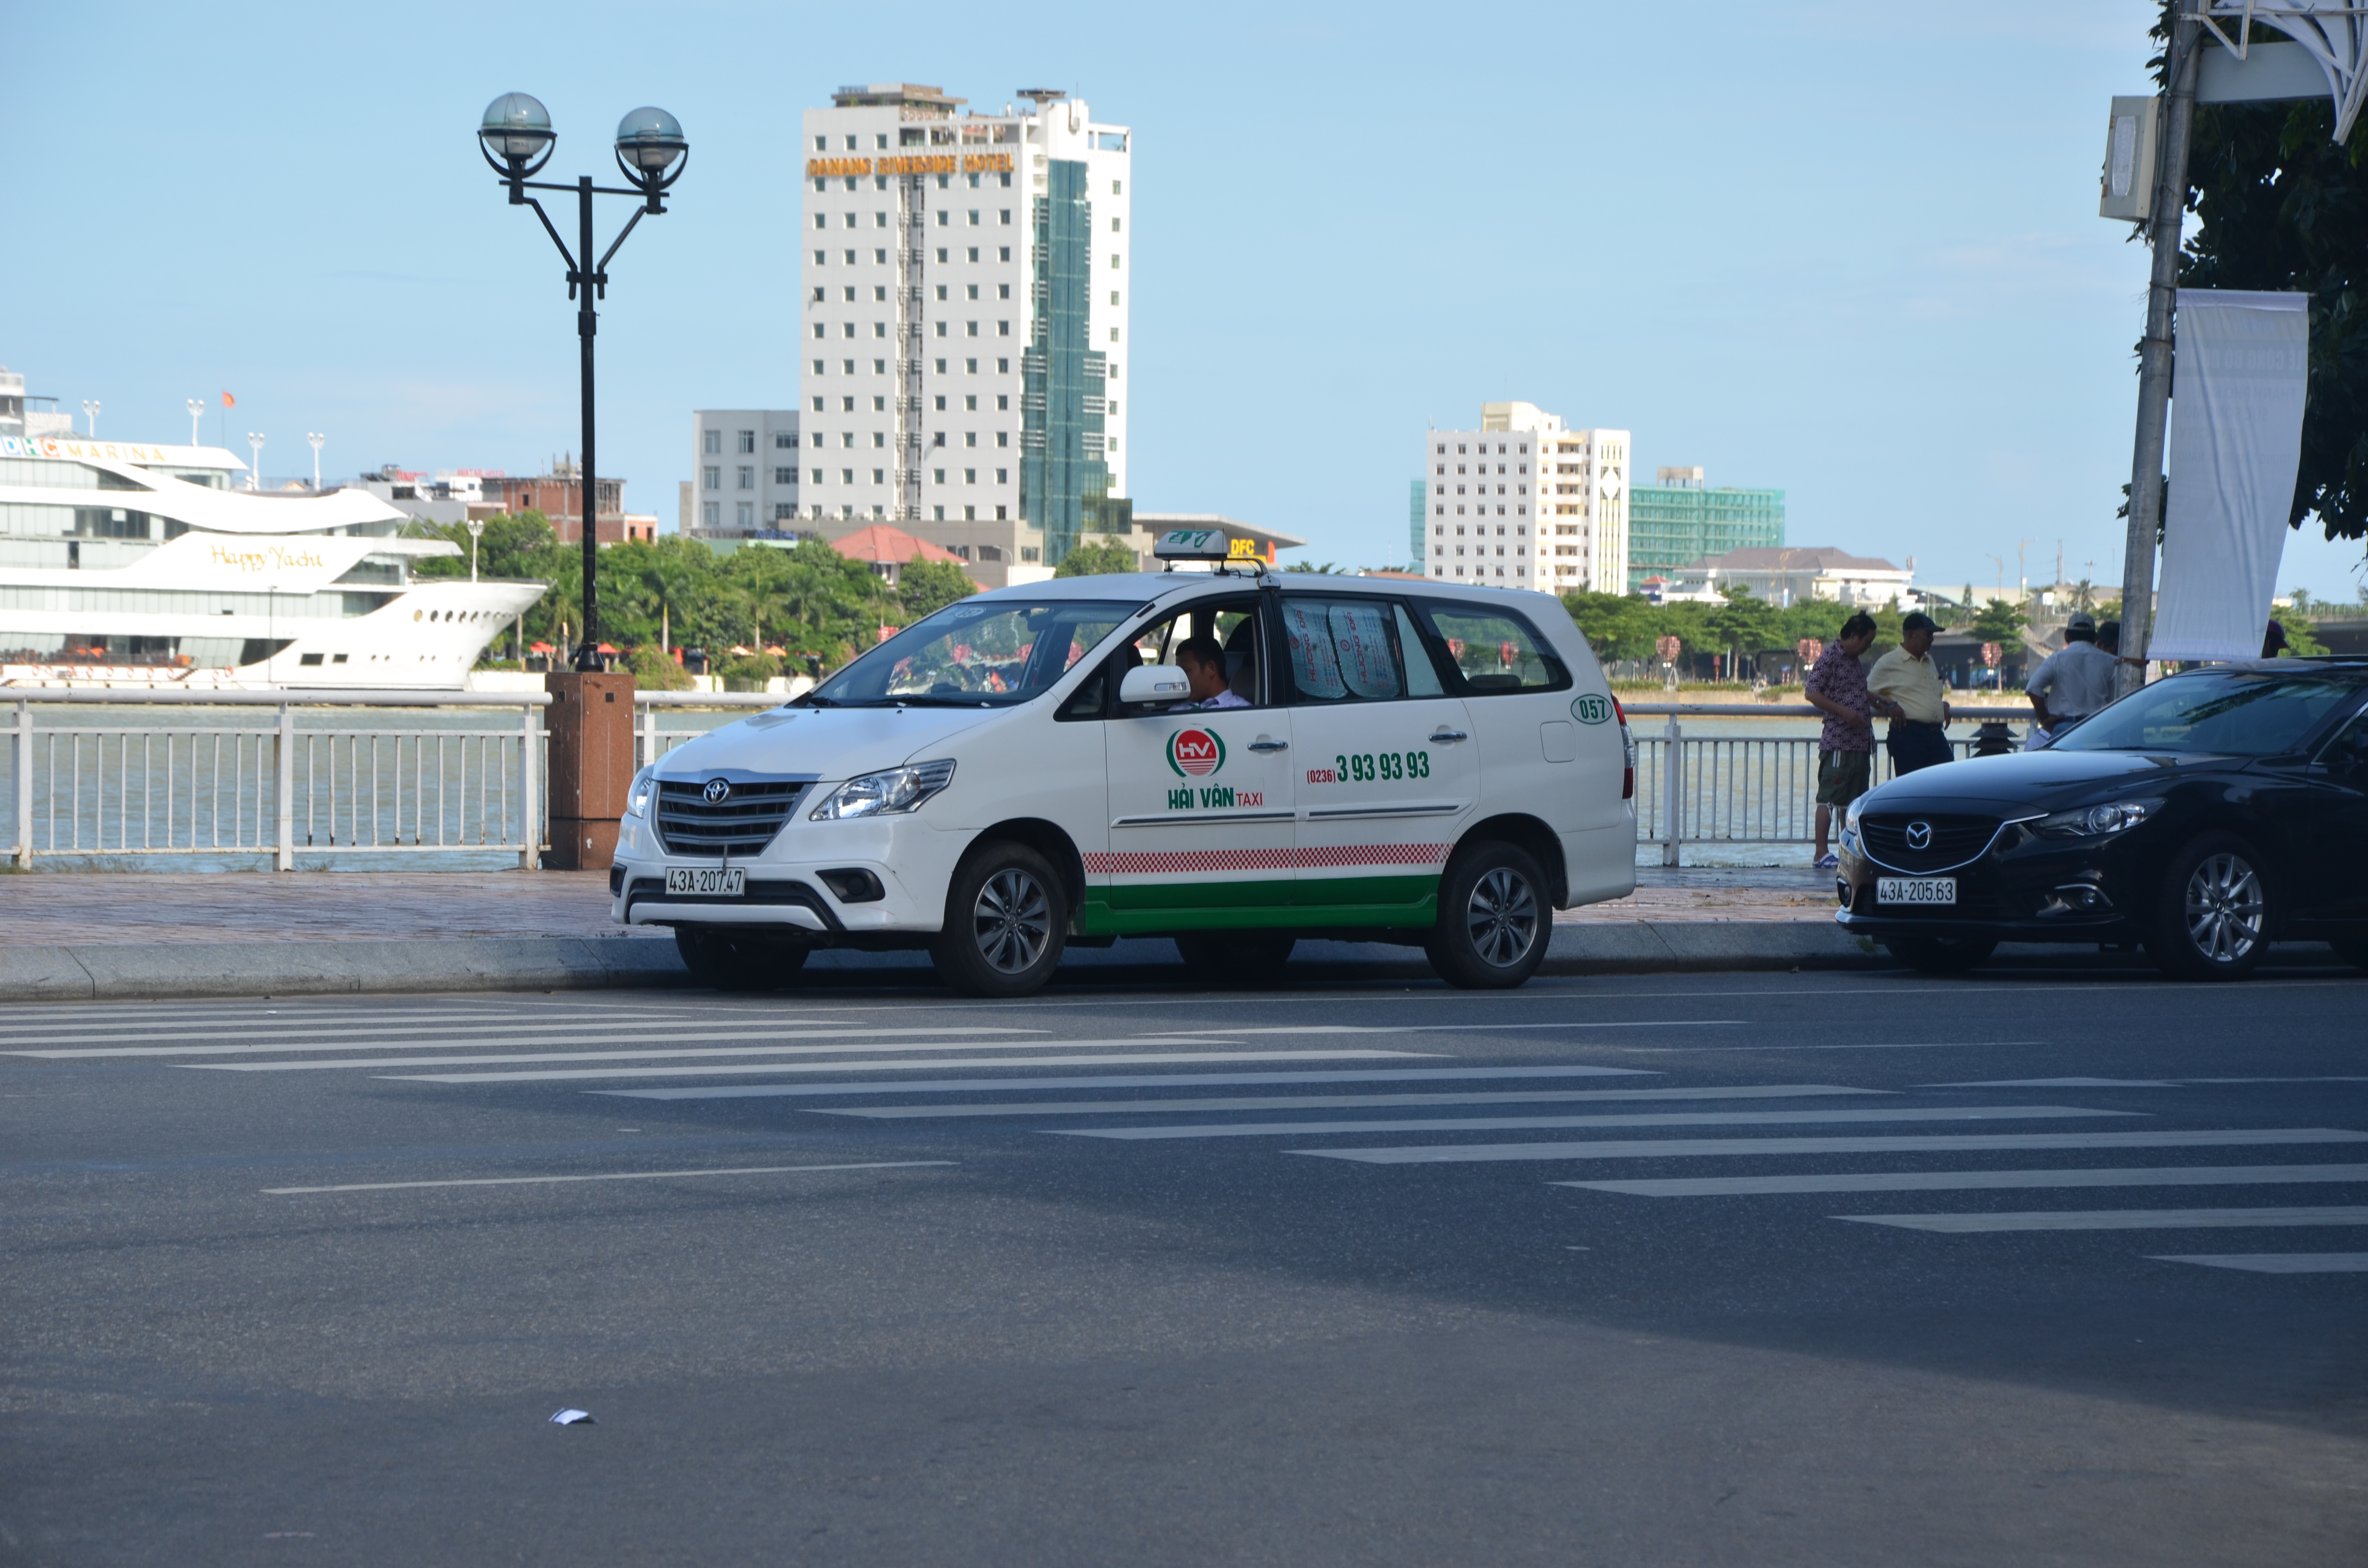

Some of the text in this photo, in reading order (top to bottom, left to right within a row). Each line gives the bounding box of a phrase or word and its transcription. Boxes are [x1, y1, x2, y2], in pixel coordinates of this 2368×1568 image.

[809, 153, 1015, 176] DANANG RIVERSIDE HOTEL
[3, 437, 166, 462] DHC MARINA
[210, 544, 323, 572] Happy Yacht
[1231, 539, 1255, 555] DFC
[1579, 699, 1605, 719] 057
[1179, 742, 1210, 758] HV
[1307, 751, 1430, 784] (0236) 3 93 93 93
[1168, 783, 1263, 810] HẢI VÂN TAXI
[669, 870, 742, 892] 43A-207.47
[1880, 882, 1953, 901] 43A-205.63
